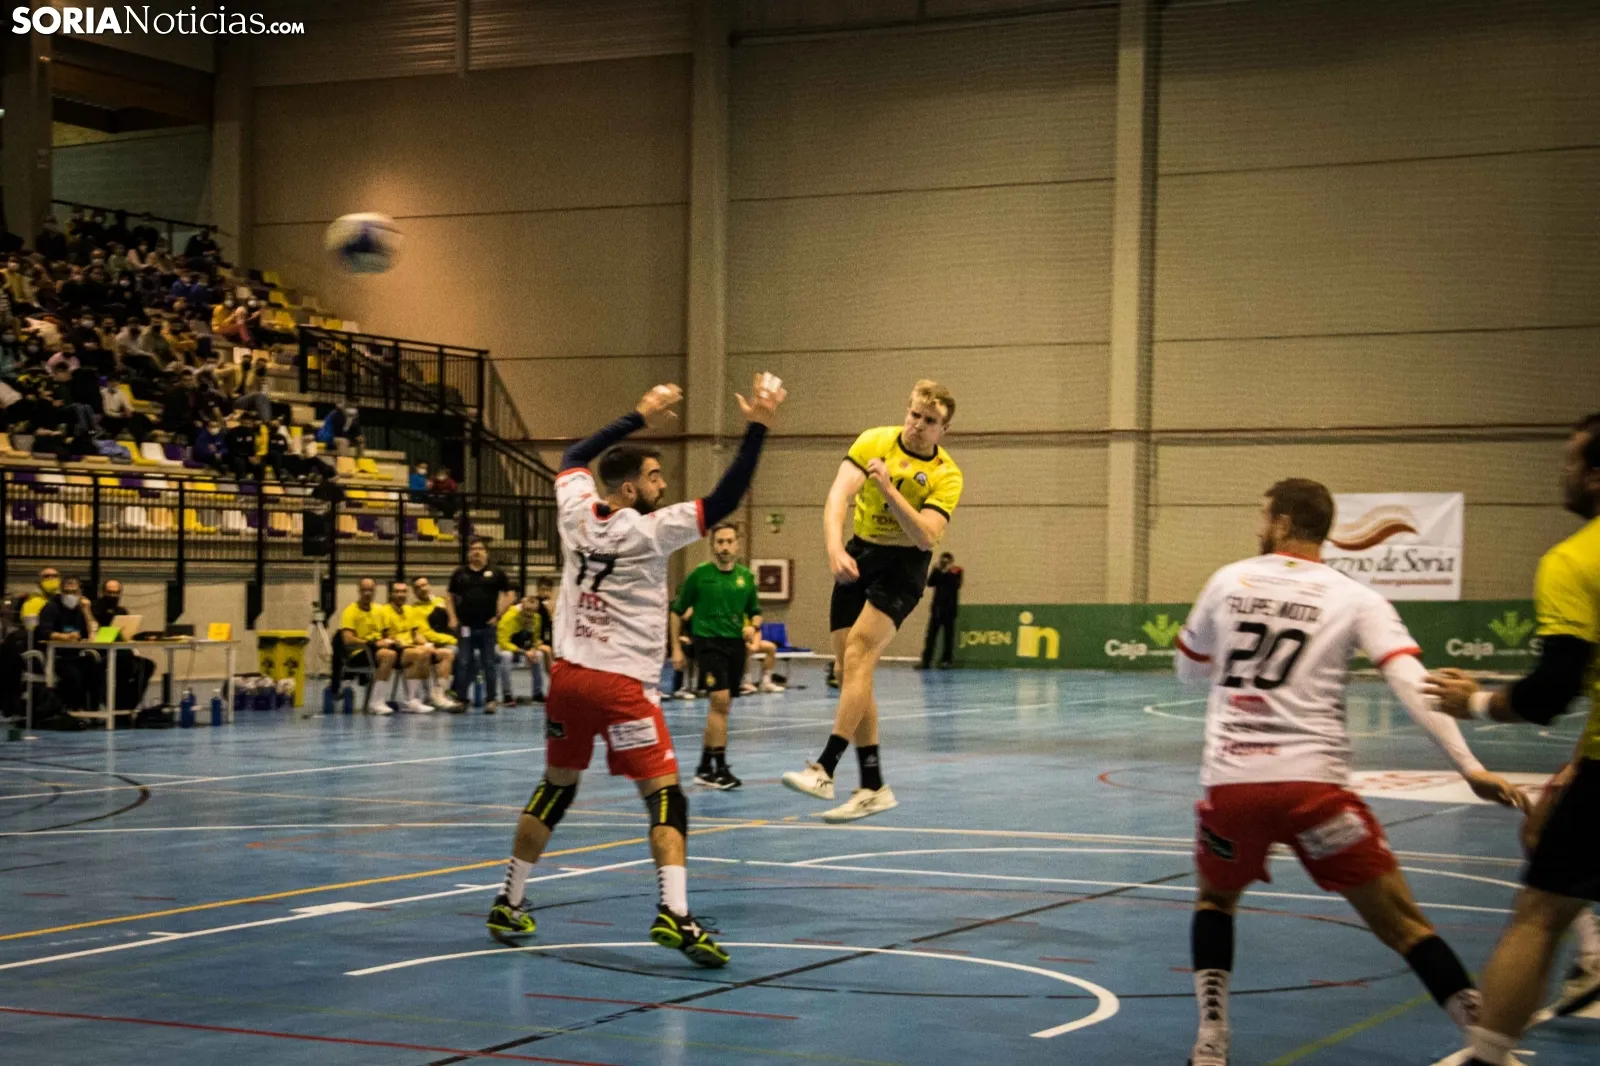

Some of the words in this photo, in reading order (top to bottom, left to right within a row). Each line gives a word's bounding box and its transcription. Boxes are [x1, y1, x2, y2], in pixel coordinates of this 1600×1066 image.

[1400, 548, 1456, 573] Soria
[959, 631, 1012, 648] JOVEN
[1016, 611, 1060, 659] in
[1104, 639, 1148, 660] Caja
[1220, 621, 1308, 690] 20
[1445, 638, 1494, 660] Caja
